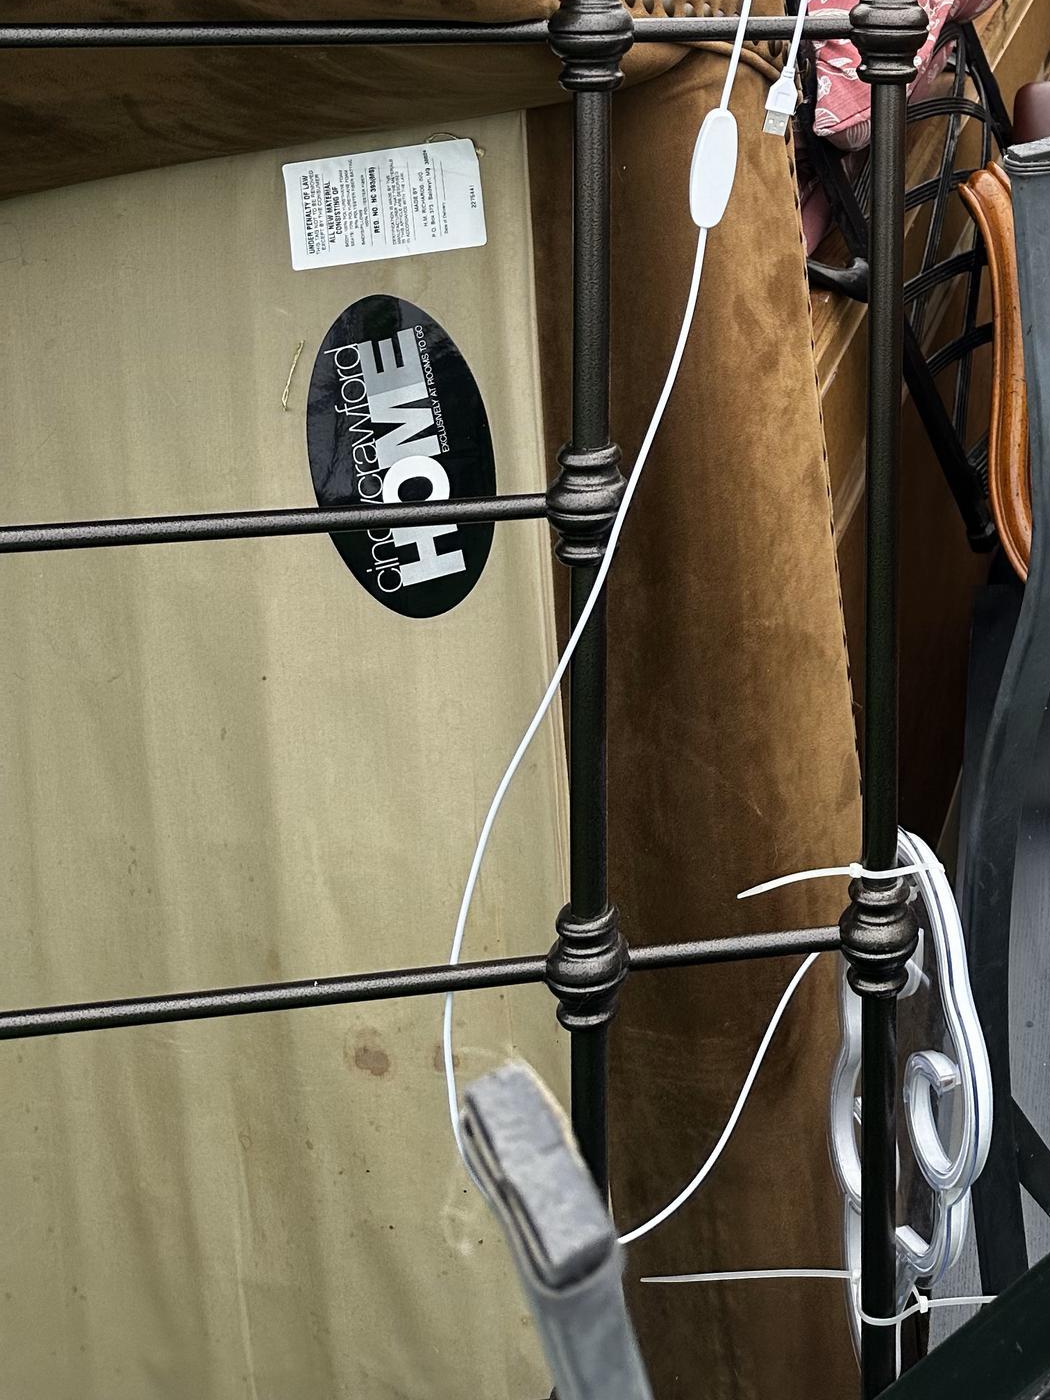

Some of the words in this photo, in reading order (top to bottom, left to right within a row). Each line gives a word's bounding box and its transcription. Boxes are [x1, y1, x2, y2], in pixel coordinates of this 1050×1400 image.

[303, 191, 309, 199] OF
[324, 181, 332, 212] MATERIAL
[332, 186, 338, 194] OF
[304, 201, 312, 229] PENALTY
[332, 196, 342, 234] CONSISTING
[307, 231, 315, 254] UNDER
[413, 324, 424, 339] GO
[417, 339, 427, 352] TO
[420, 352, 435, 386] ROOMS
[428, 387, 438, 397] AT
[431, 399, 450, 453] EXCLUSIVELY
[357, 327, 467, 587] HOME
